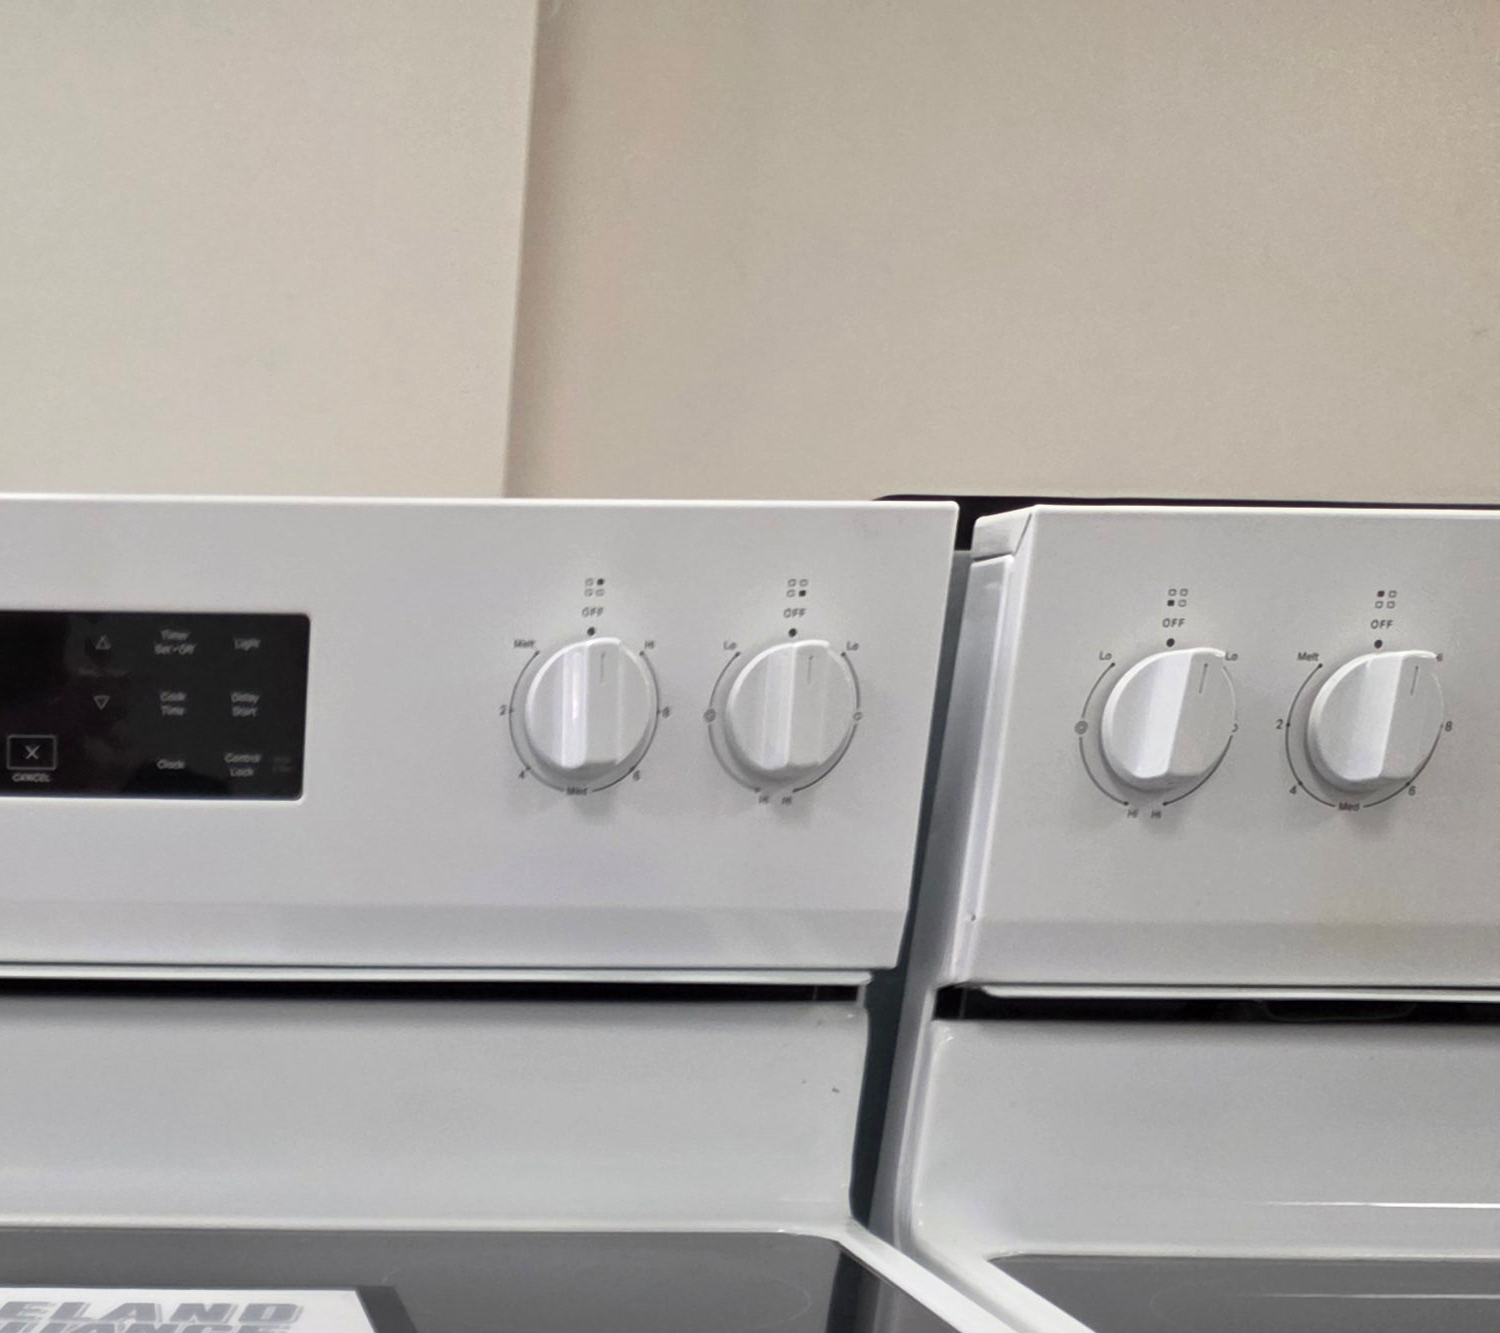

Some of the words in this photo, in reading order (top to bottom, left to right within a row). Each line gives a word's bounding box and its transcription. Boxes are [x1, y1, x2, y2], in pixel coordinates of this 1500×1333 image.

[1162, 617, 1186, 628] OFF
[1370, 620, 1394, 631] OFF
[1099, 650, 1113, 662] Lo
[1298, 650, 1319, 662] Melt
[1276, 719, 1284, 731] 2
[1444, 721, 1453, 732] 8
[1289, 786, 1298, 797] 4
[1408, 786, 1417, 798] 6
[1338, 801, 1360, 813] Med
